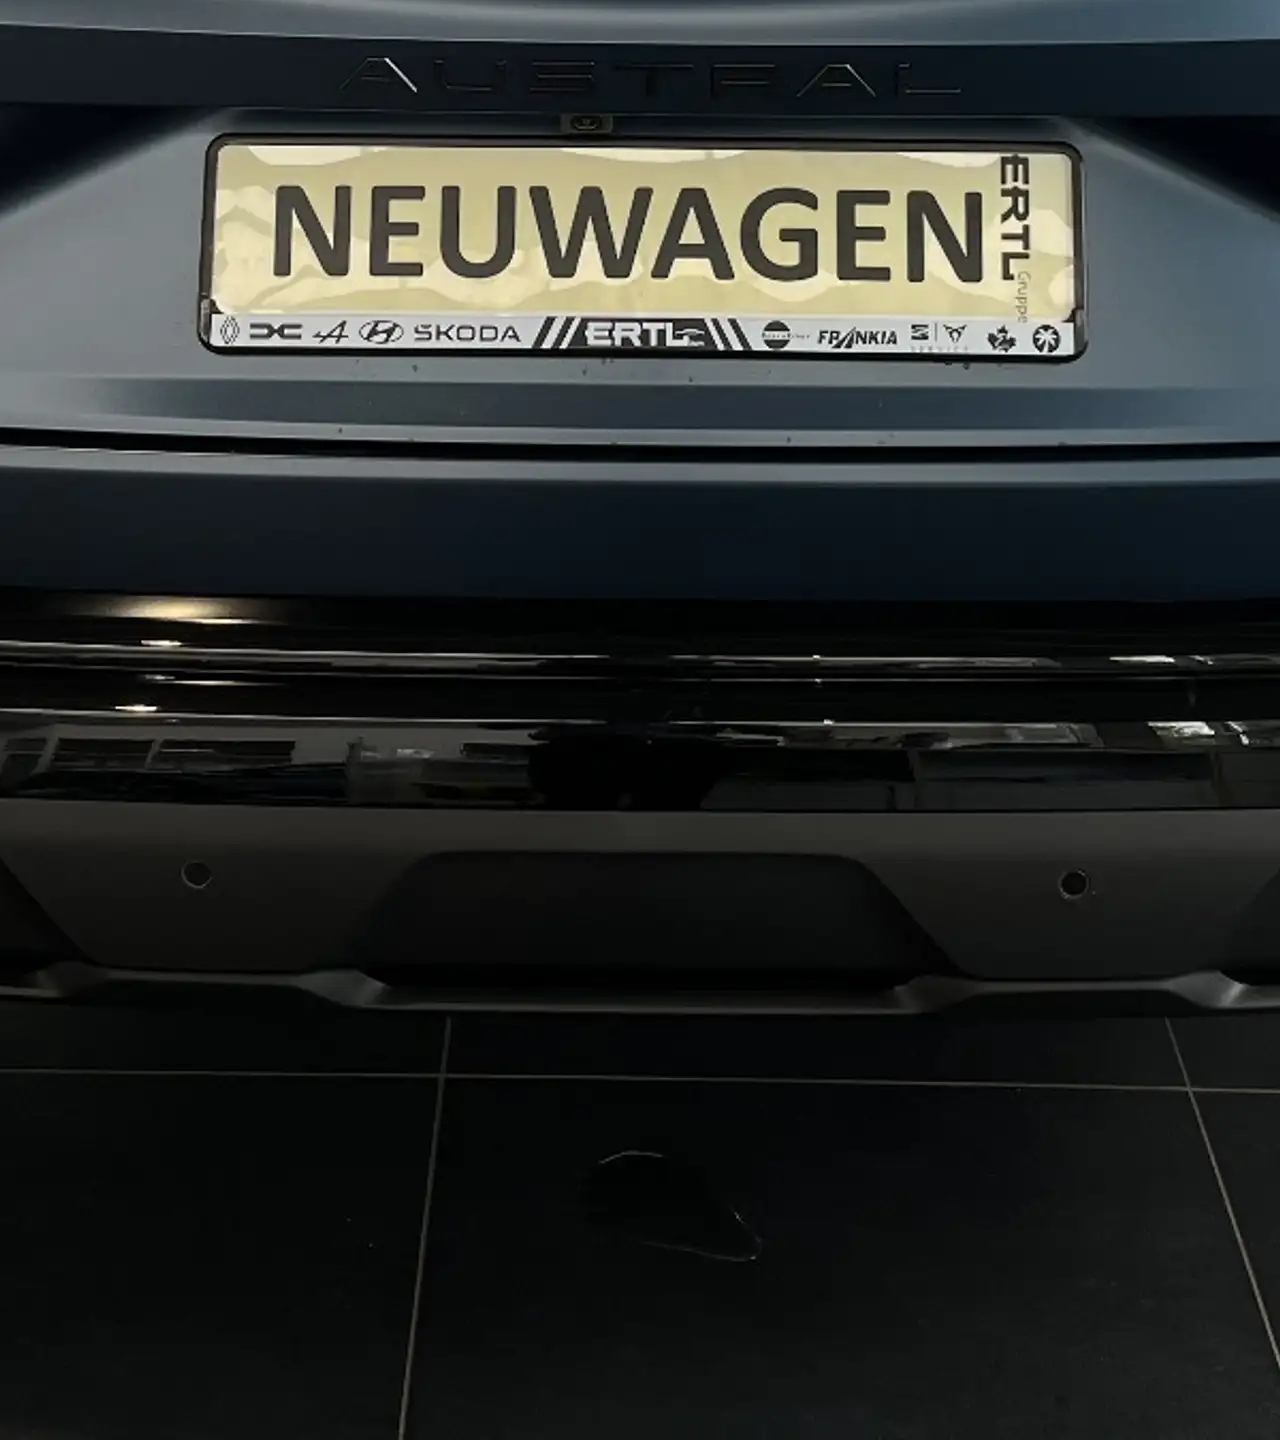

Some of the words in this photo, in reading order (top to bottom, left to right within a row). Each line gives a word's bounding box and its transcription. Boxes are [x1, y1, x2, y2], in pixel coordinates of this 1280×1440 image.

[338, 55, 963, 99] AUSTRAL
[271, 186, 984, 282] NEUWAGEN
[1000, 153, 1031, 281] ERTL
[1015, 270, 1031, 323] Gruppe
[584, 321, 690, 347] ERTL
[817, 328, 899, 350] FRANKIA
